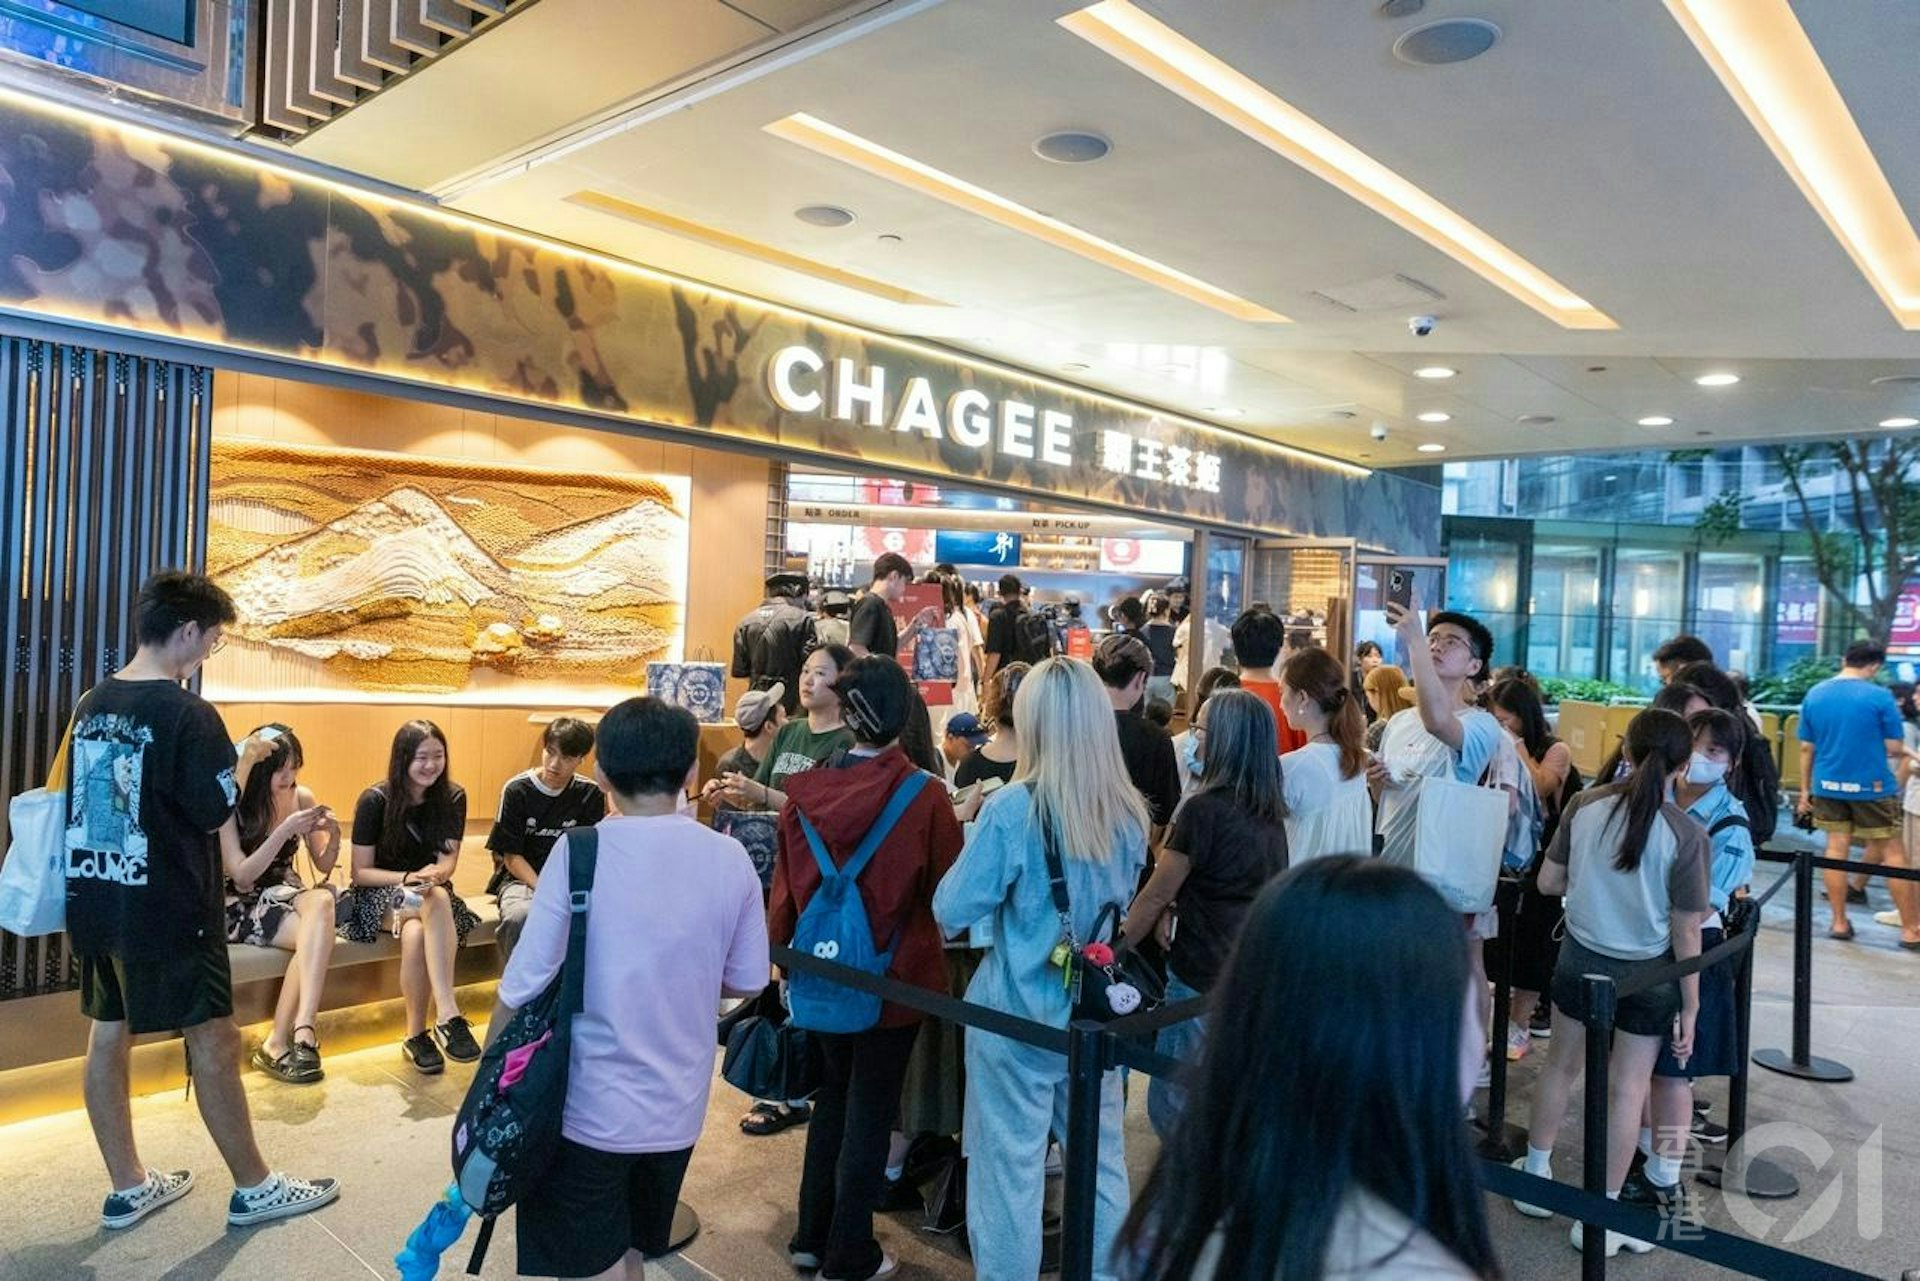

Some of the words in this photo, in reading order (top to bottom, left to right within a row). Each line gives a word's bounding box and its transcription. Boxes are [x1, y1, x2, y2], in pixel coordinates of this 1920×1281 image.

[768, 345, 1073, 466] CHAGEE
[1055, 520, 1076, 528] PICK
[1078, 520, 1091, 529] UP
